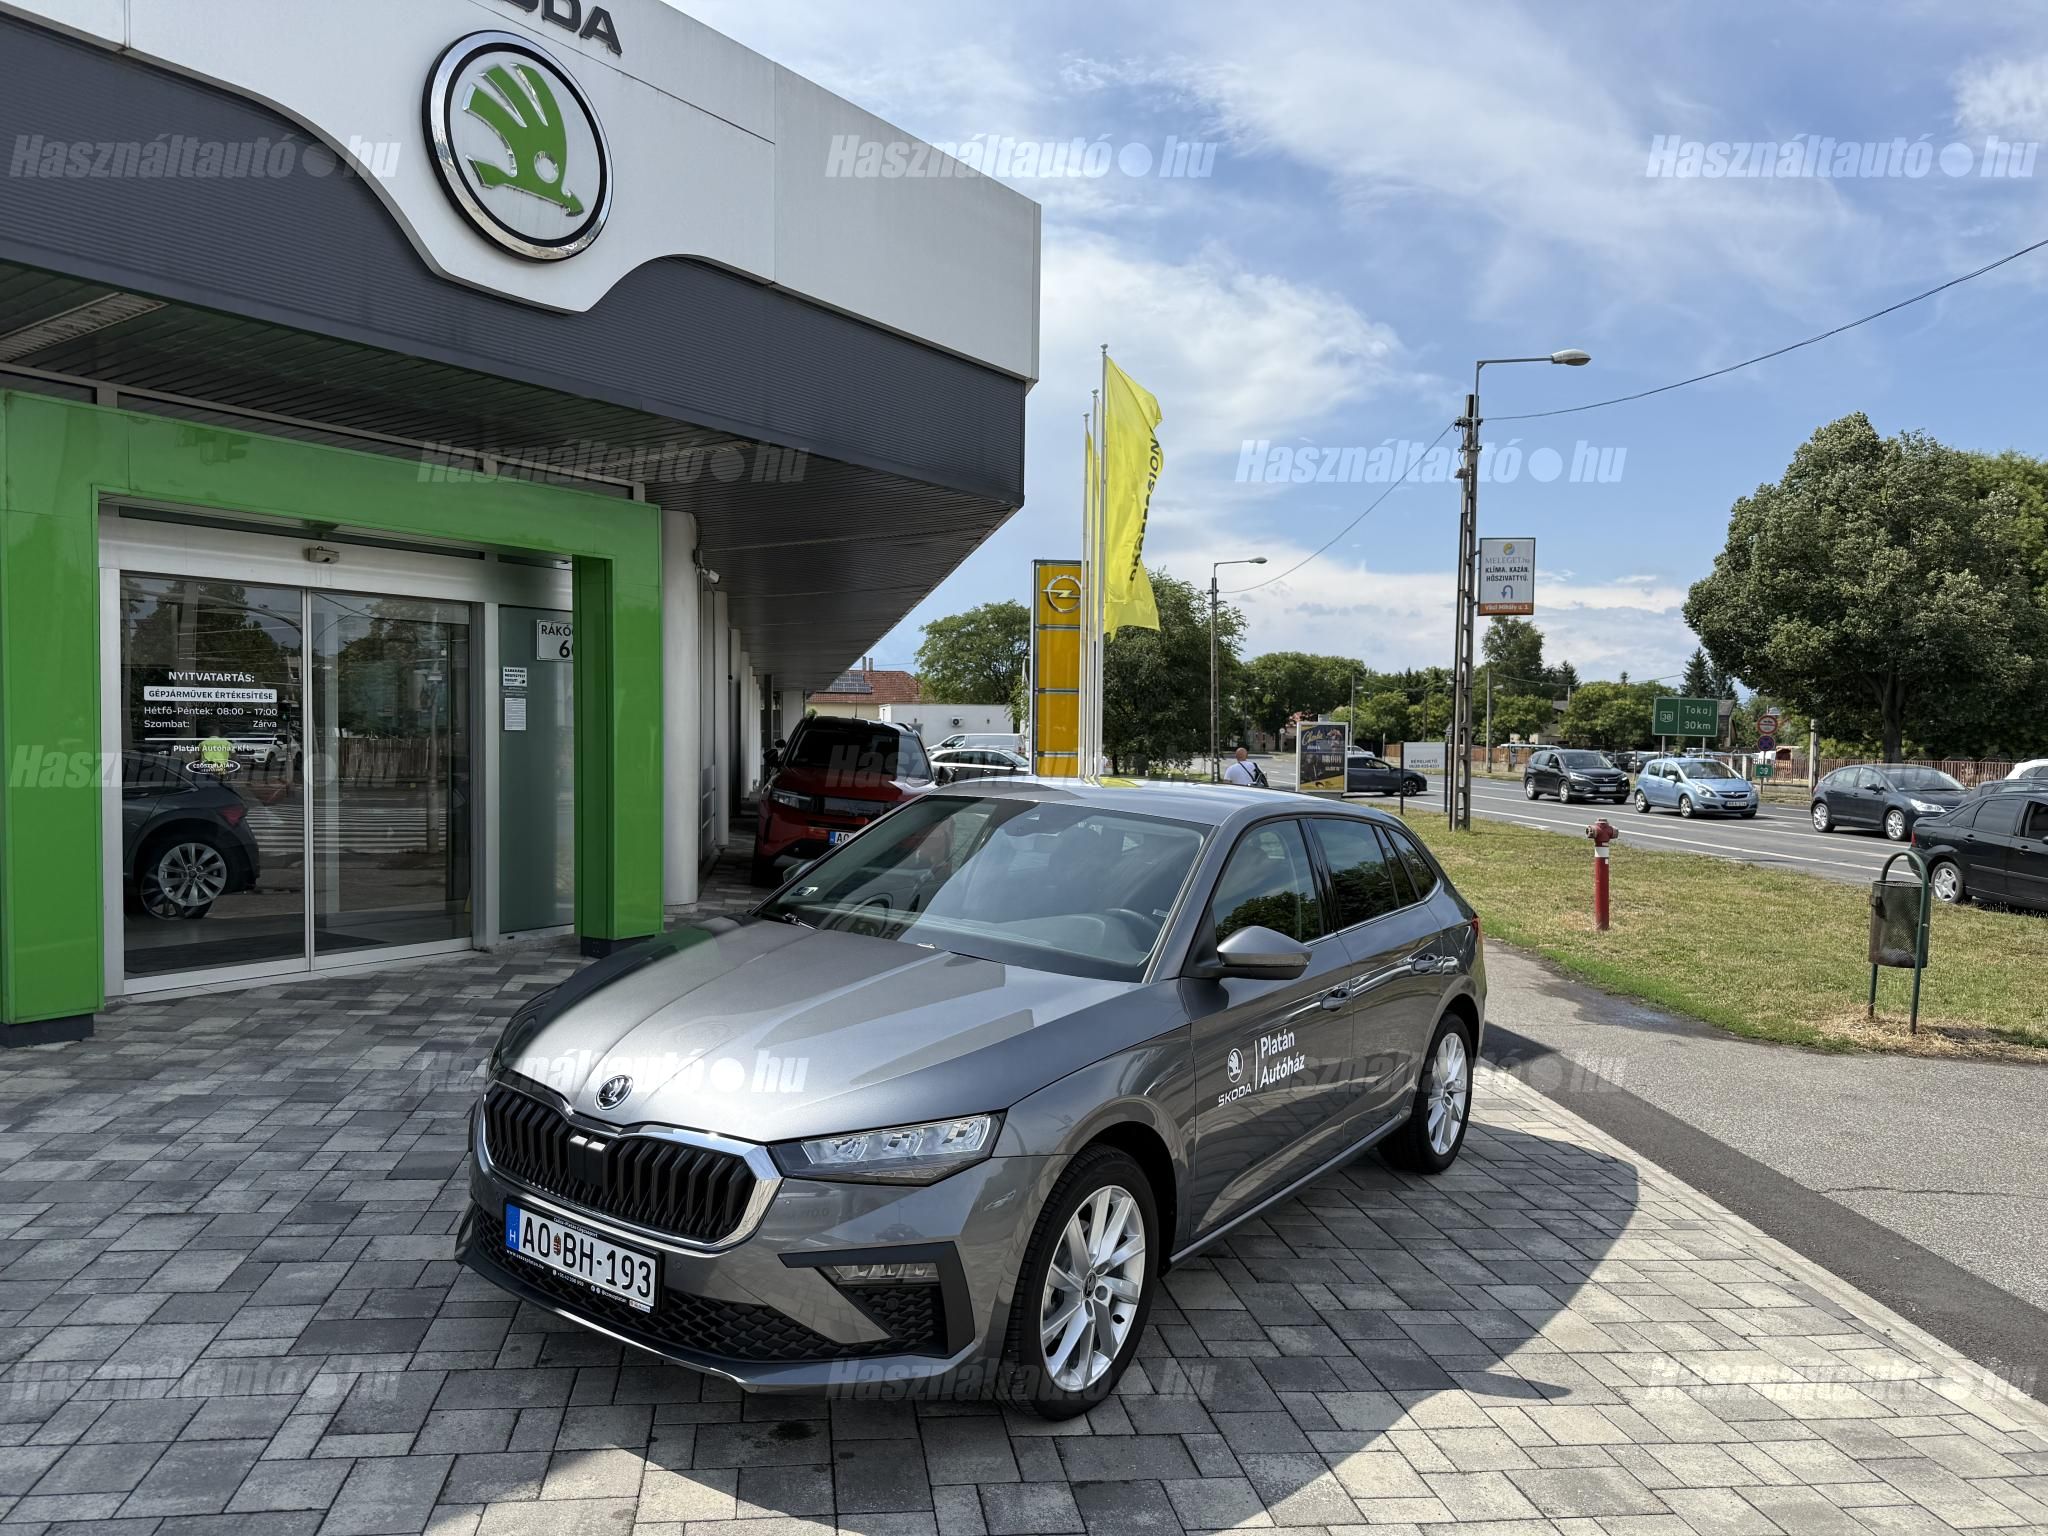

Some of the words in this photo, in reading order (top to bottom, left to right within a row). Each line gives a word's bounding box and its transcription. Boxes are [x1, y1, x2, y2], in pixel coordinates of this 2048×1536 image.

[504, 0, 622, 57] DA
[541, 624, 574, 637] RÁKÓ
[559, 640, 574, 658] 6
[168, 671, 255, 683] NYITVATARTÁS:
[214, 689, 273, 700] ÉRTÉKESÍTÉSE
[216, 707, 244, 716] 08:00
[254, 708, 278, 716] 17:00
[1684, 705, 1712, 716] Tokaj
[144, 720, 190, 728] Szombat:
[252, 720, 277, 728] Zárva
[173, 744, 200, 752] Platán
[1260, 1028, 1295, 1059] Platán
[1260, 1051, 1305, 1088] Autóház
[509, 1229, 516, 1243] H
